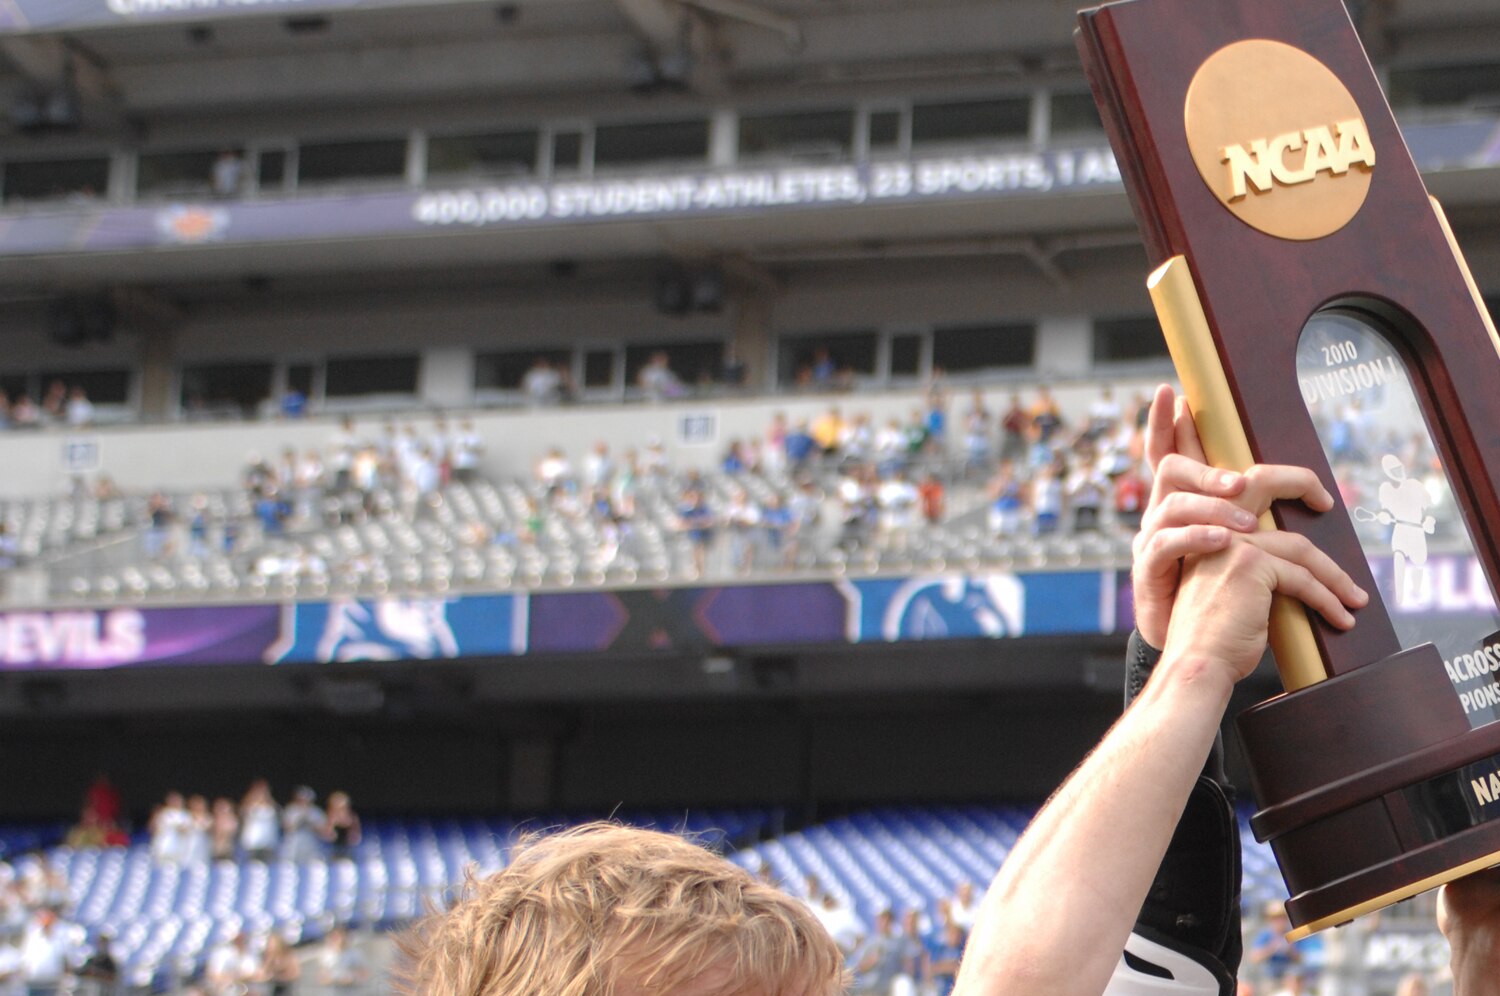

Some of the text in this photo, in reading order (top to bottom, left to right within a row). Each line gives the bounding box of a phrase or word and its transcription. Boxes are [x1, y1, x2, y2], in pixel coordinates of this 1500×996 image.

[1220, 117, 1377, 204] NCAA
[413, 187, 547, 226] 400,000
[870, 161, 912, 197] 23
[1301, 358, 1387, 404] DIVISION
[1321, 340, 1358, 367] 2010
[0, 608, 147, 664] EVILS
